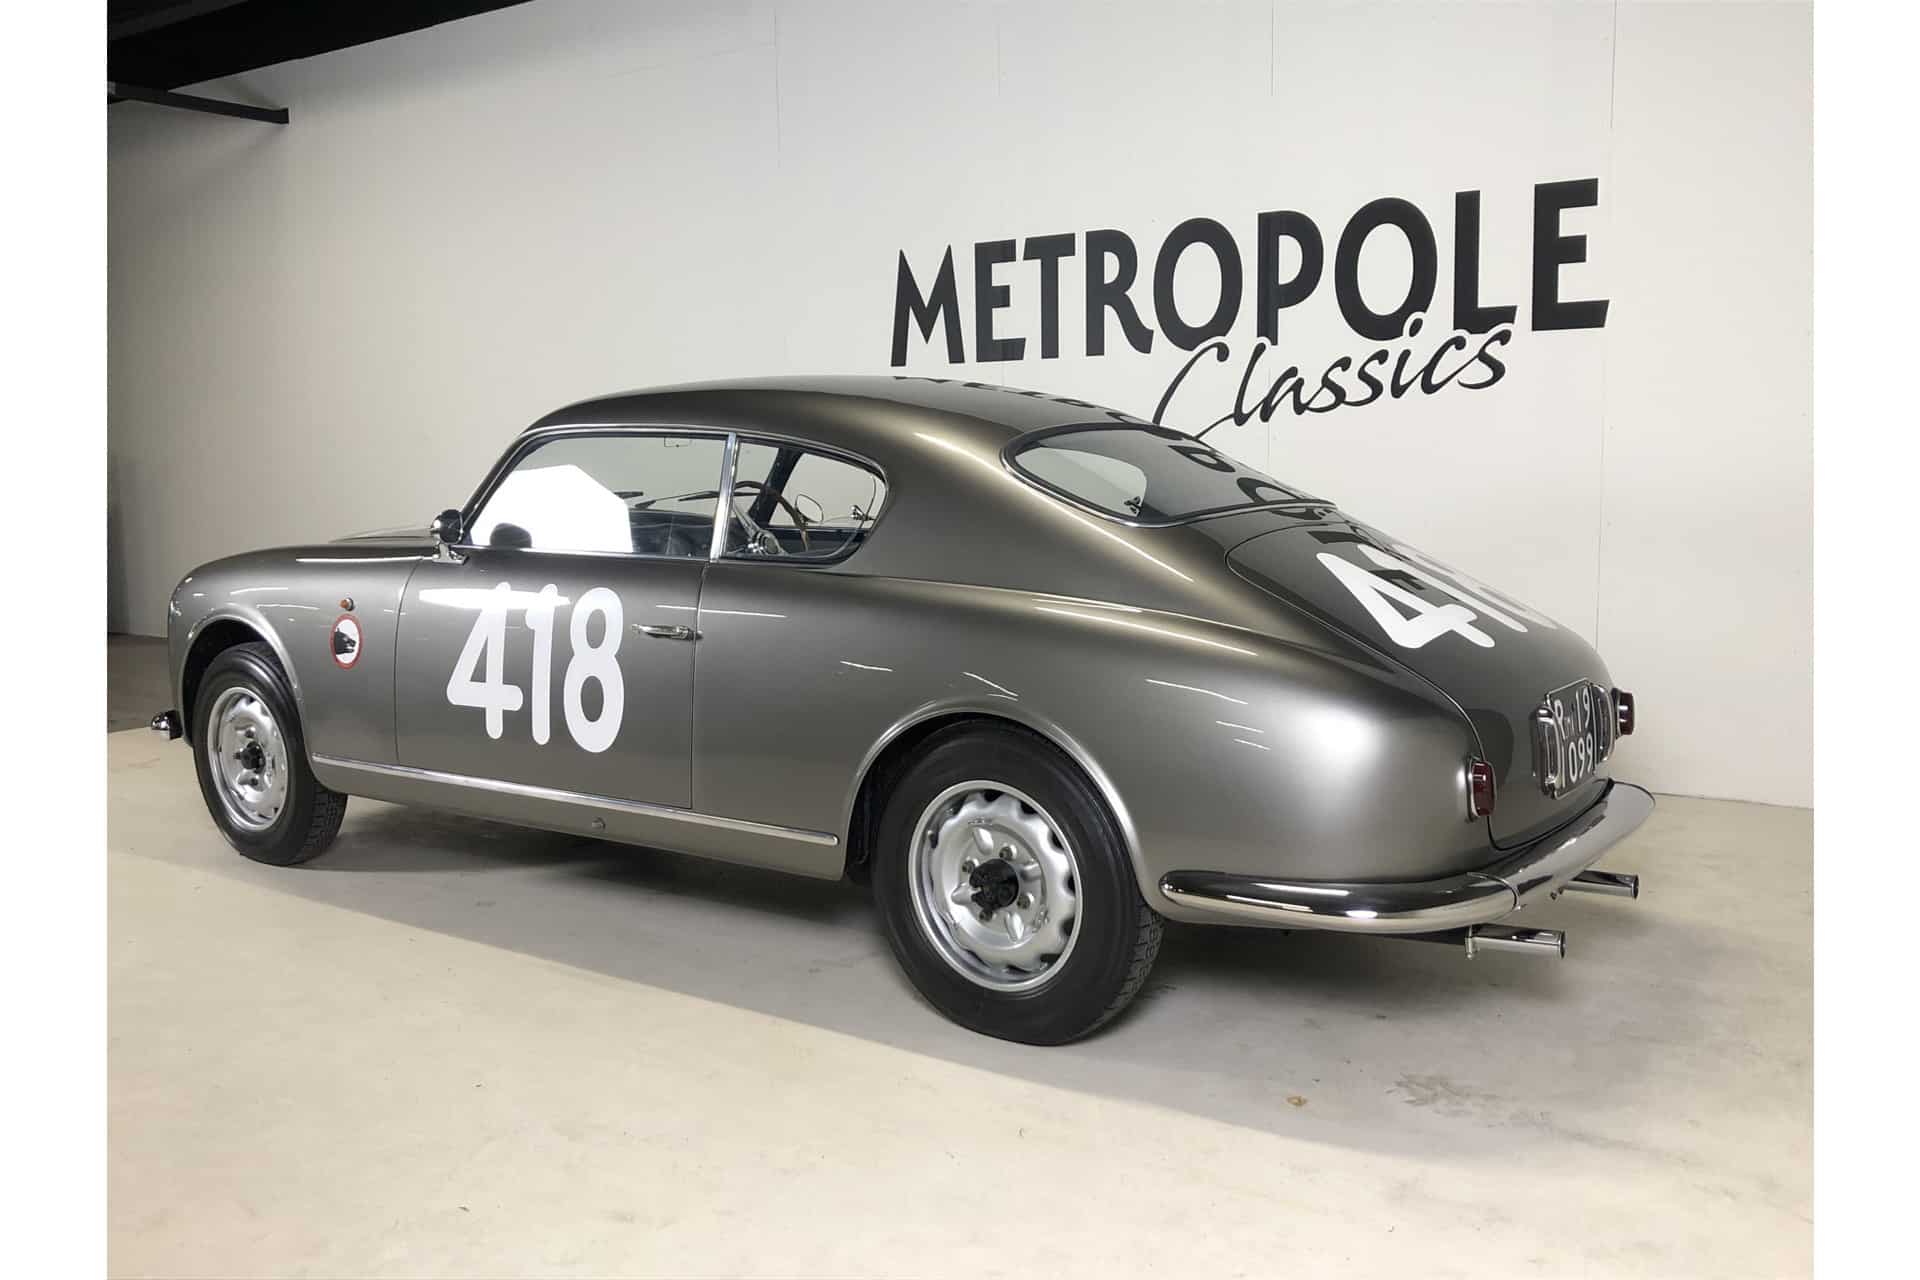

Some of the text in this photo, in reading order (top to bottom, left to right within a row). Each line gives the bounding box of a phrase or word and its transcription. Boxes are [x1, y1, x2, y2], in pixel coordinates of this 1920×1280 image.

[890, 178, 1609, 367] METROPOLE
[1153, 312, 1512, 440] Classics
[446, 582, 625, 753] 418
[1575, 686, 1591, 732] 19
